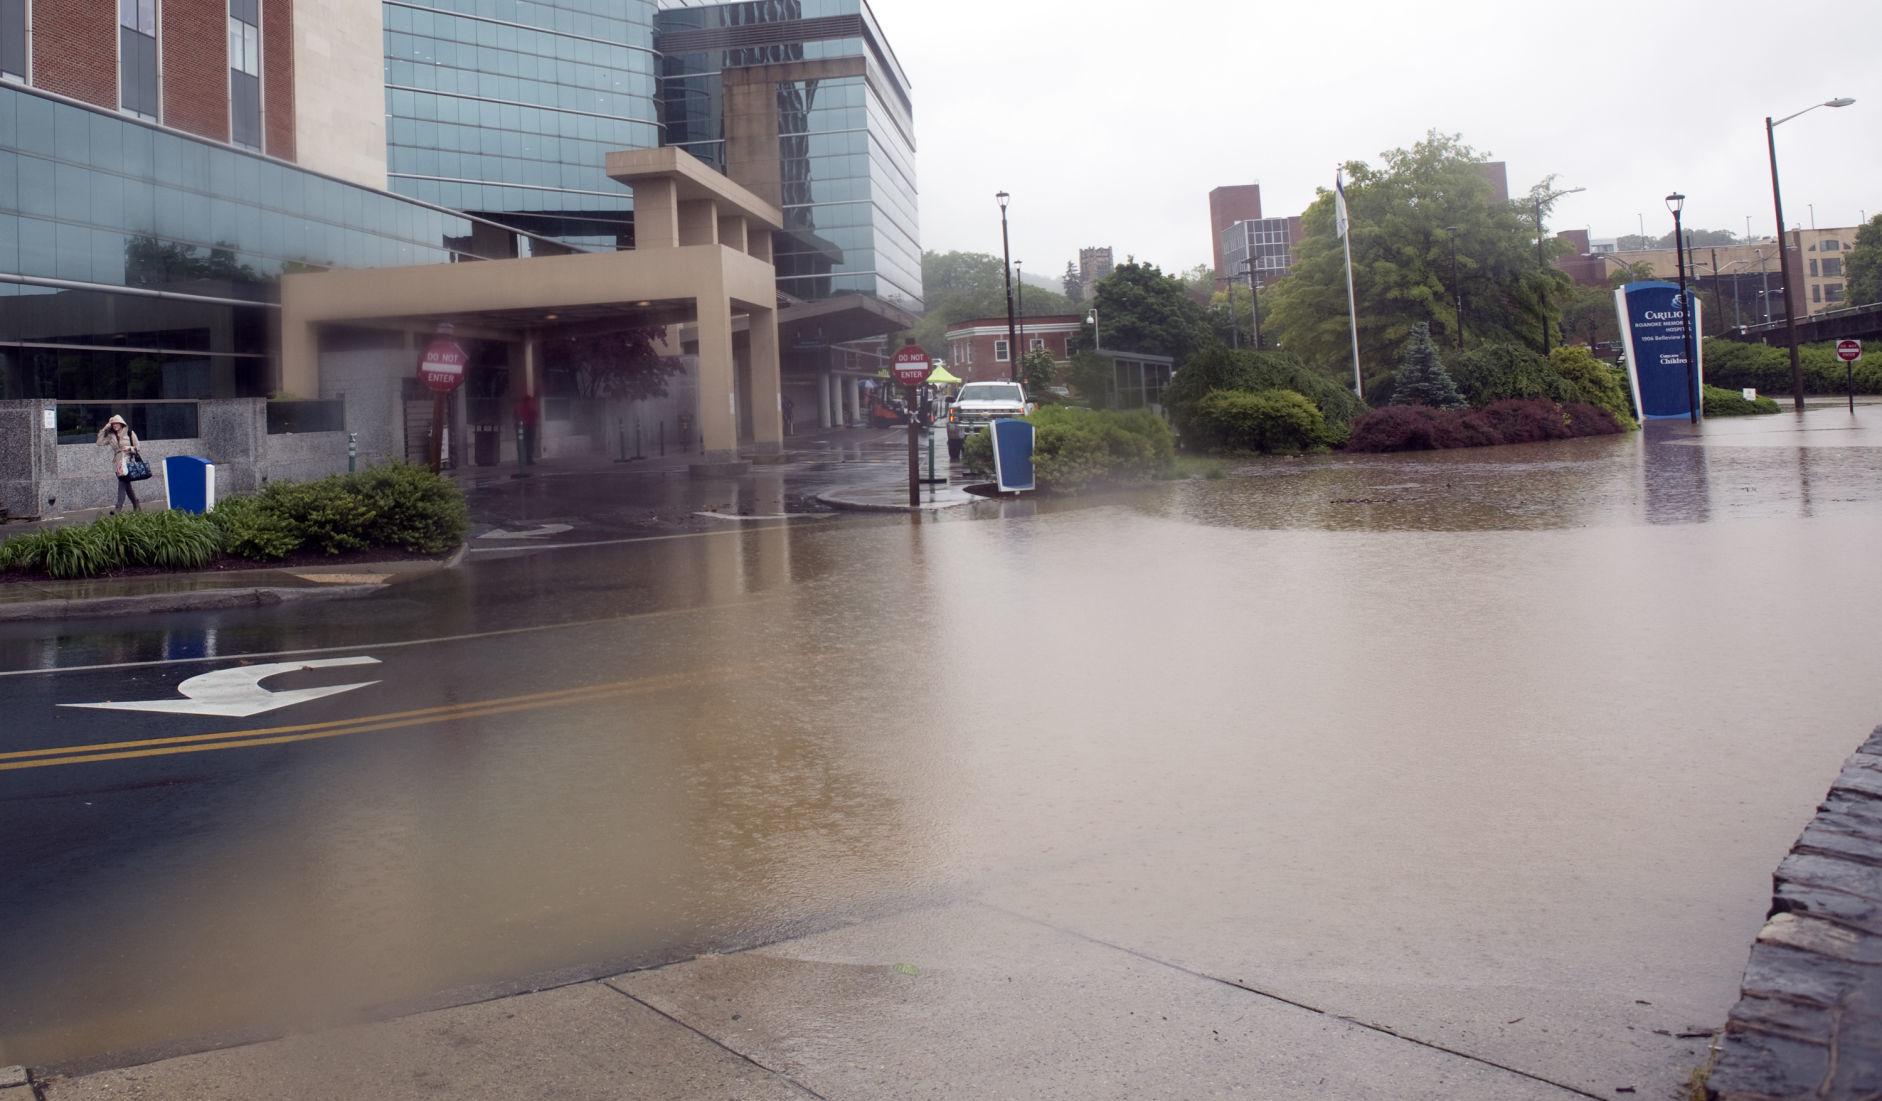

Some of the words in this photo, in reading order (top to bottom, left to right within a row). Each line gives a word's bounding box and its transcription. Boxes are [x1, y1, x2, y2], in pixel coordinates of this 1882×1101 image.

[427, 352, 439, 361] DO
[442, 353, 459, 363] NOT
[428, 373, 455, 383] ENTER
